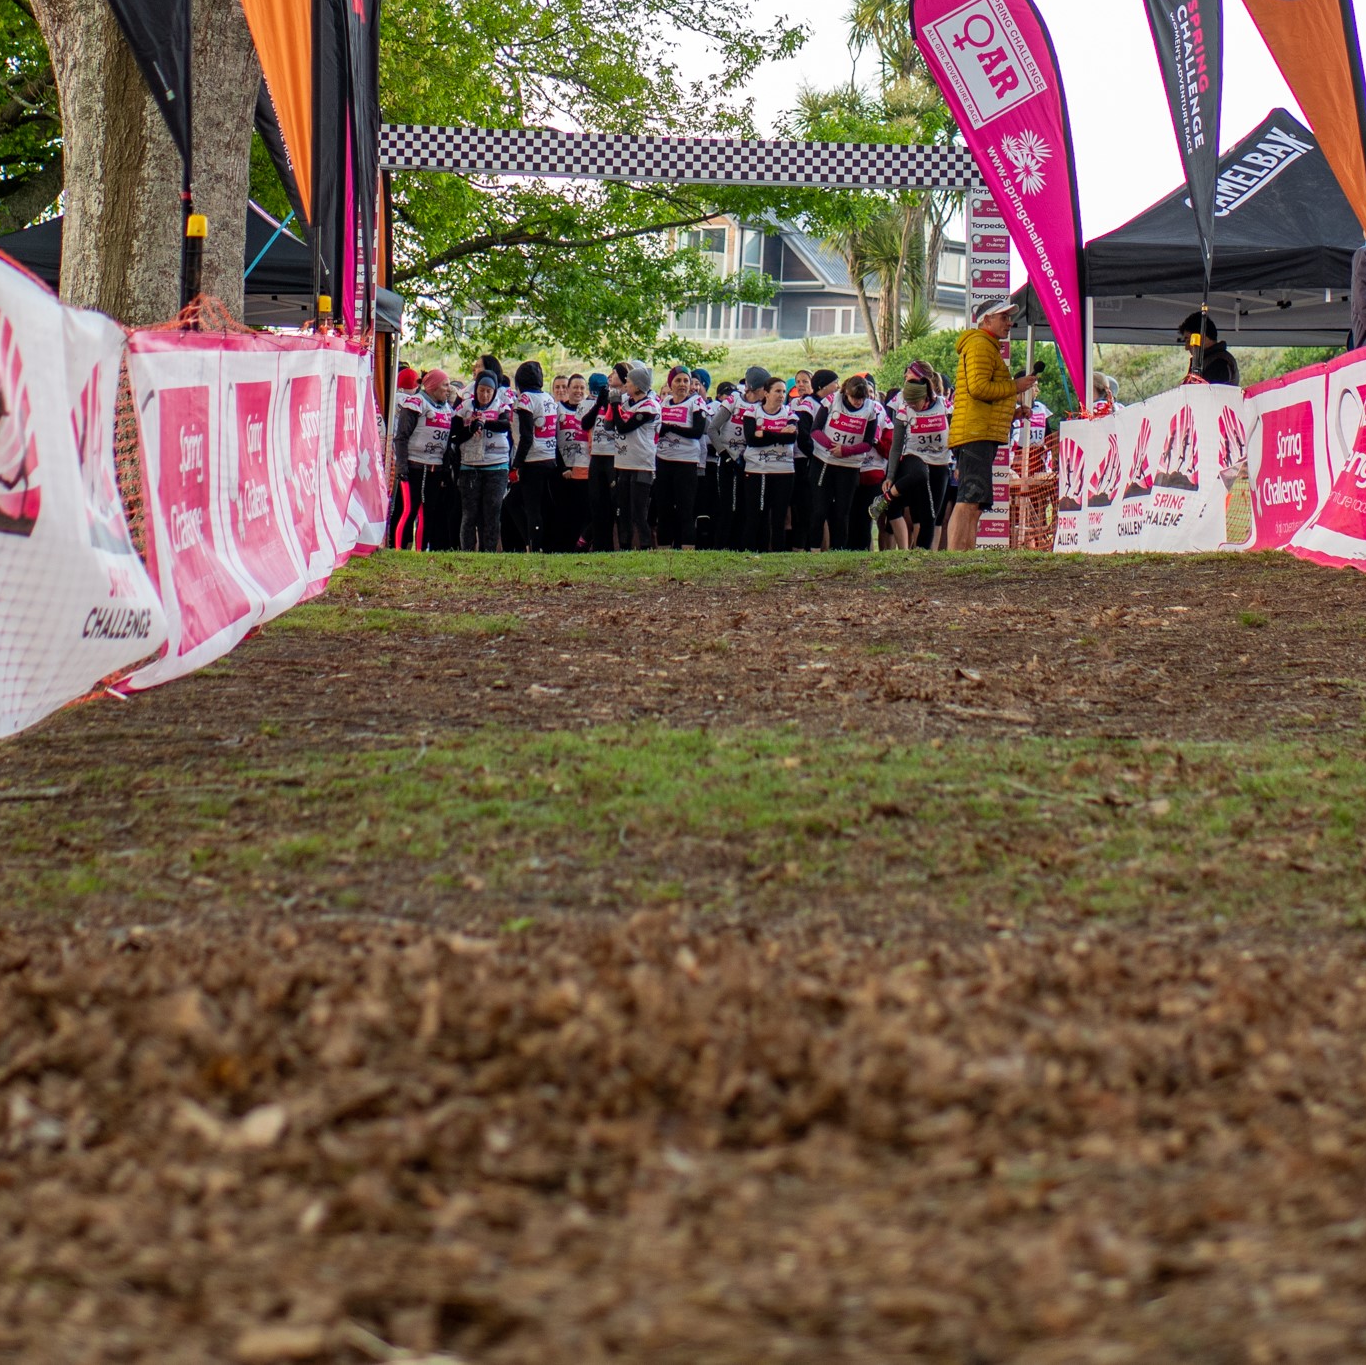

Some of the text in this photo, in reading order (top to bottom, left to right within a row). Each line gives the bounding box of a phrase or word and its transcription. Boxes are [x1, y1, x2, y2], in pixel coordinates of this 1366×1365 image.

[926, 28, 980, 125] ALL GIRL ADVENTURE RACE
[1010, 28, 1046, 91] CHALLENGE
[1170, 11, 1193, 155] WOMEN'S ADVENTURE RACE
[1176, 4, 1205, 149] CHALLENGE
[986, 145, 1072, 316] www.springchallenge.co.nz
[833, 432, 855, 445] 314
[918, 434, 942, 444] 314
[1276, 428, 1302, 468] Spring
[1263, 476, 1308, 511] Challenge
[82, 607, 152, 639] CHALLENGE
